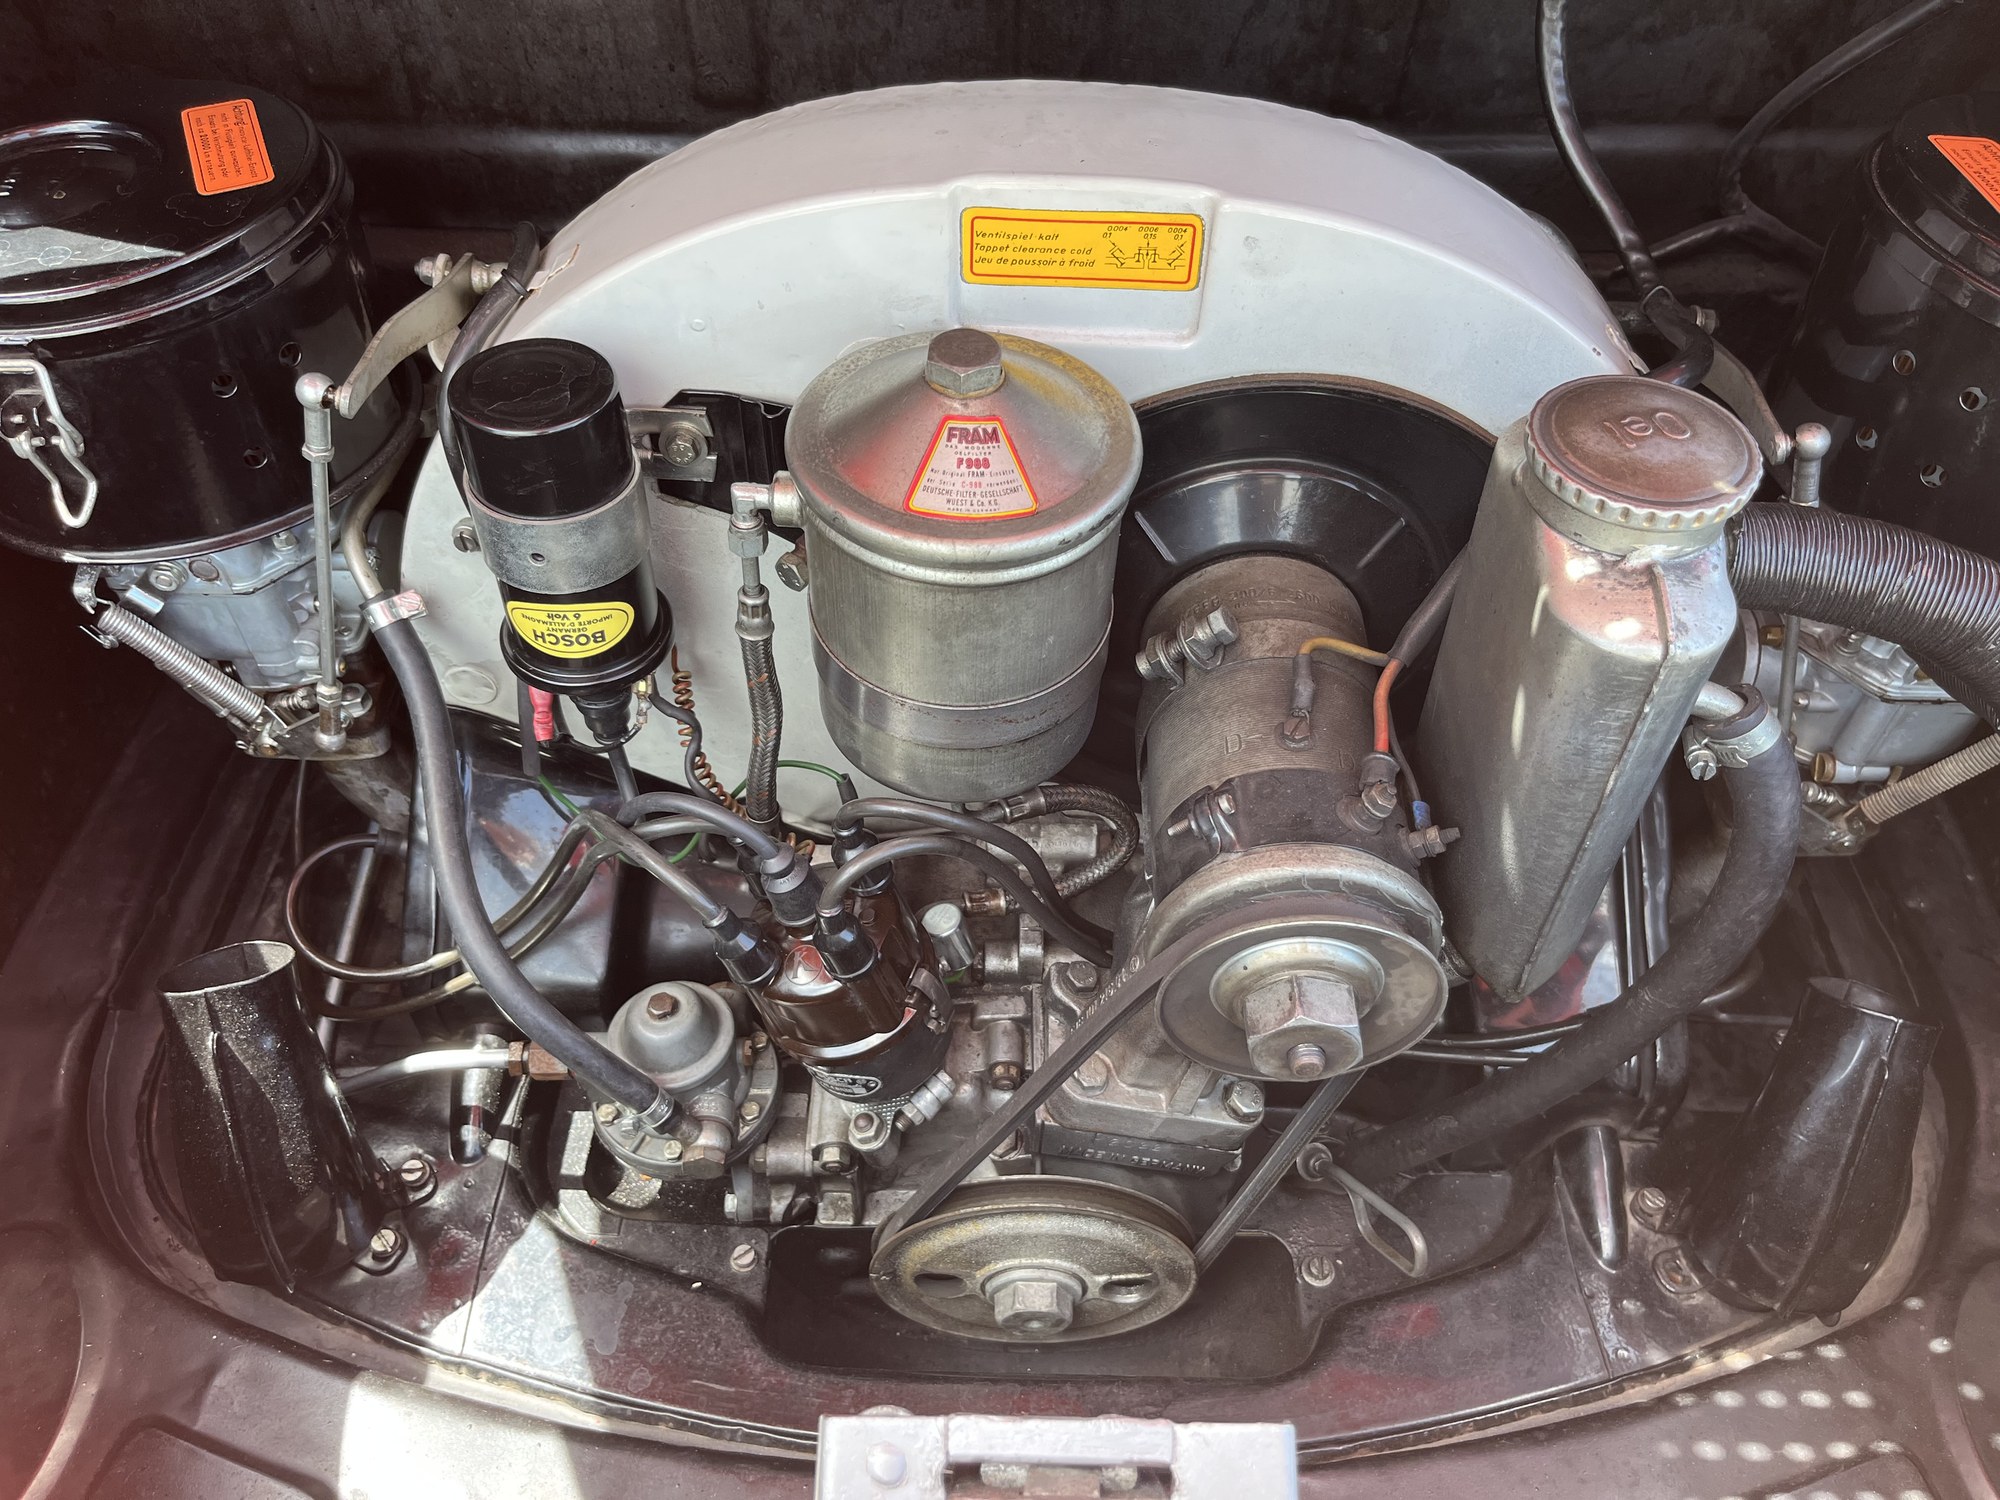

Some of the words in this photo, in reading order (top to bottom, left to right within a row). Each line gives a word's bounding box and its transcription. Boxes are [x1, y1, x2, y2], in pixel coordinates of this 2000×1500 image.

[975, 230, 1033, 241] Ventilspiel
[1038, 233, 1060, 241] kalt
[974, 243, 1010, 253] Tappet
[1012, 245, 1066, 255] clearance
[1070, 248, 1092, 256] cold
[974, 256, 993, 264] Jeu
[996, 257, 1009, 265] de
[1010, 258, 1058, 267] poussoir
[1068, 259, 1095, 268] froid
[946, 426, 1001, 445] FRAM
[946, 498, 967, 507] WUEST
[546, 613, 571, 621] Volt
[578, 614, 613, 627] IMPORTE
[532, 629, 606, 647] BOSCH
